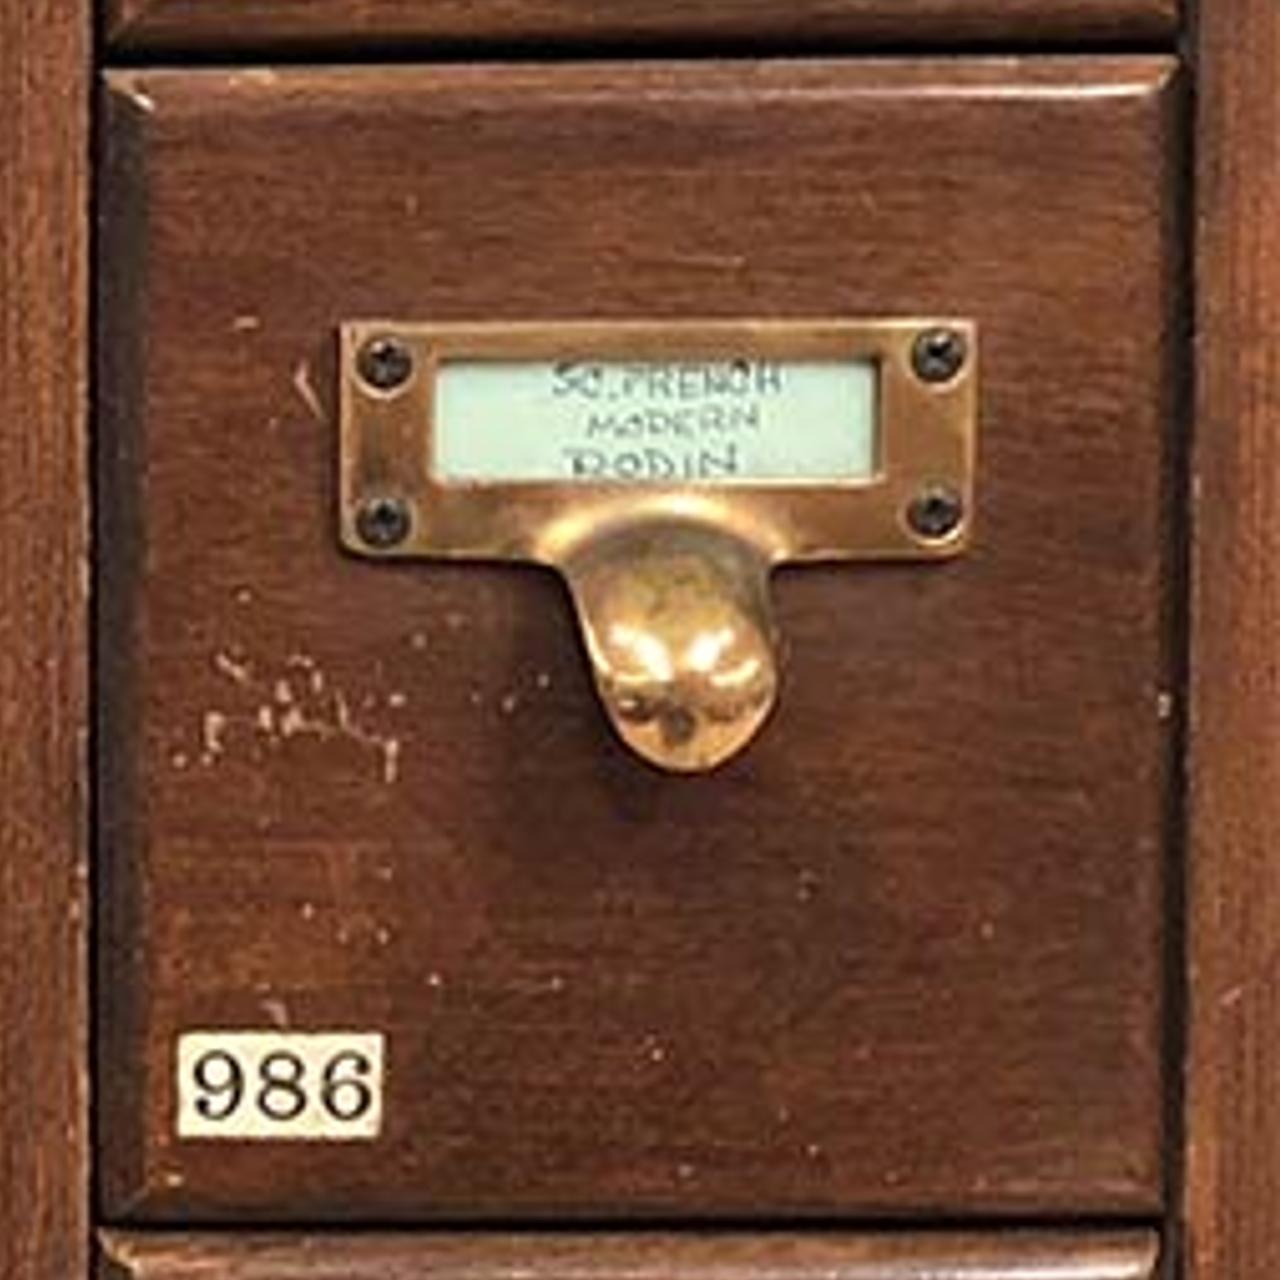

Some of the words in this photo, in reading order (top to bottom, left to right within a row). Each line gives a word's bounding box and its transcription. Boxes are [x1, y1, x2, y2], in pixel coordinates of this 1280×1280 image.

[585, 404, 762, 439] MODERN
[563, 441, 740, 480] RODIN
[192, 1049, 373, 1123] 986
